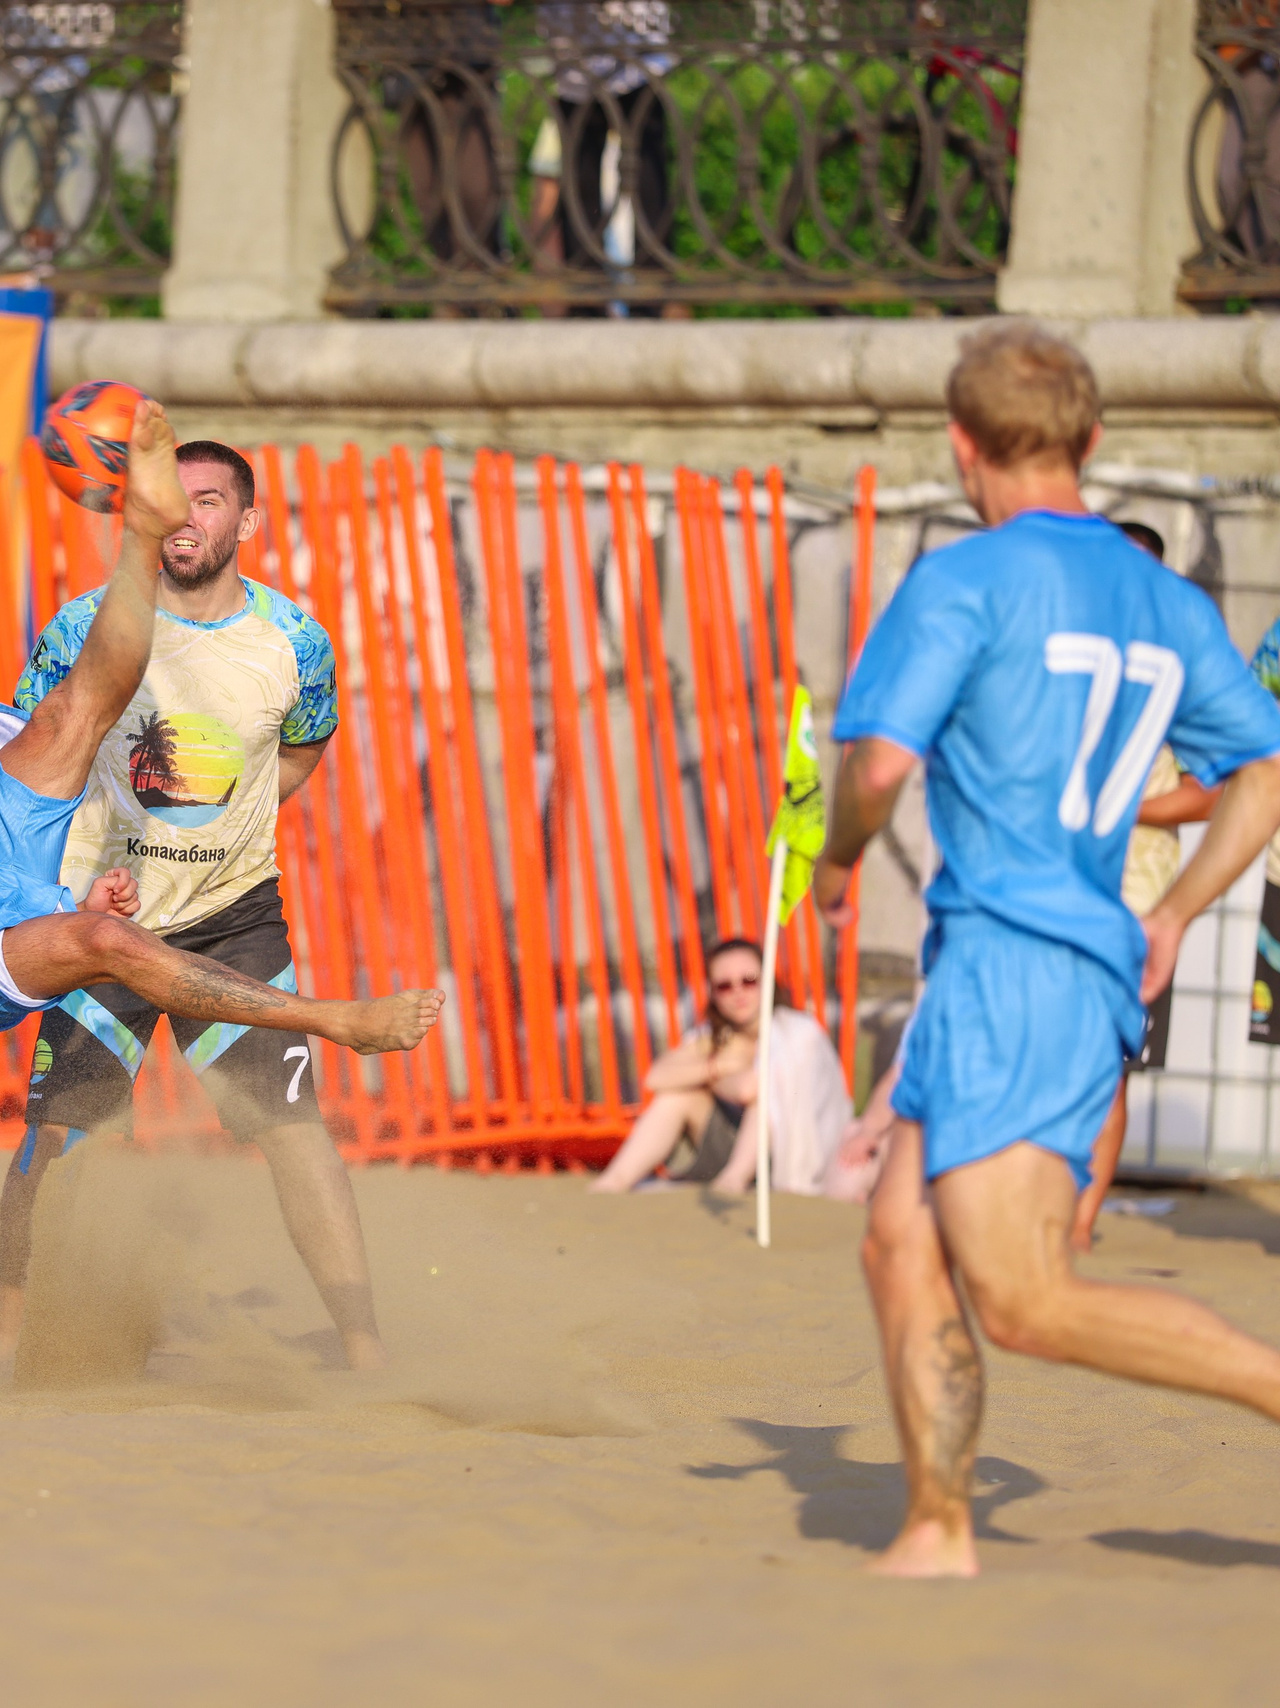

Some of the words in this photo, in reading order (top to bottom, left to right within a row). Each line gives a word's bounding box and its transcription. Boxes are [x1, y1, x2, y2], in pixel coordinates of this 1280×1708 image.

[1044, 631, 1185, 838] 77
[126, 837, 228, 863] Копакабана
[283, 1045, 310, 1104] 7
